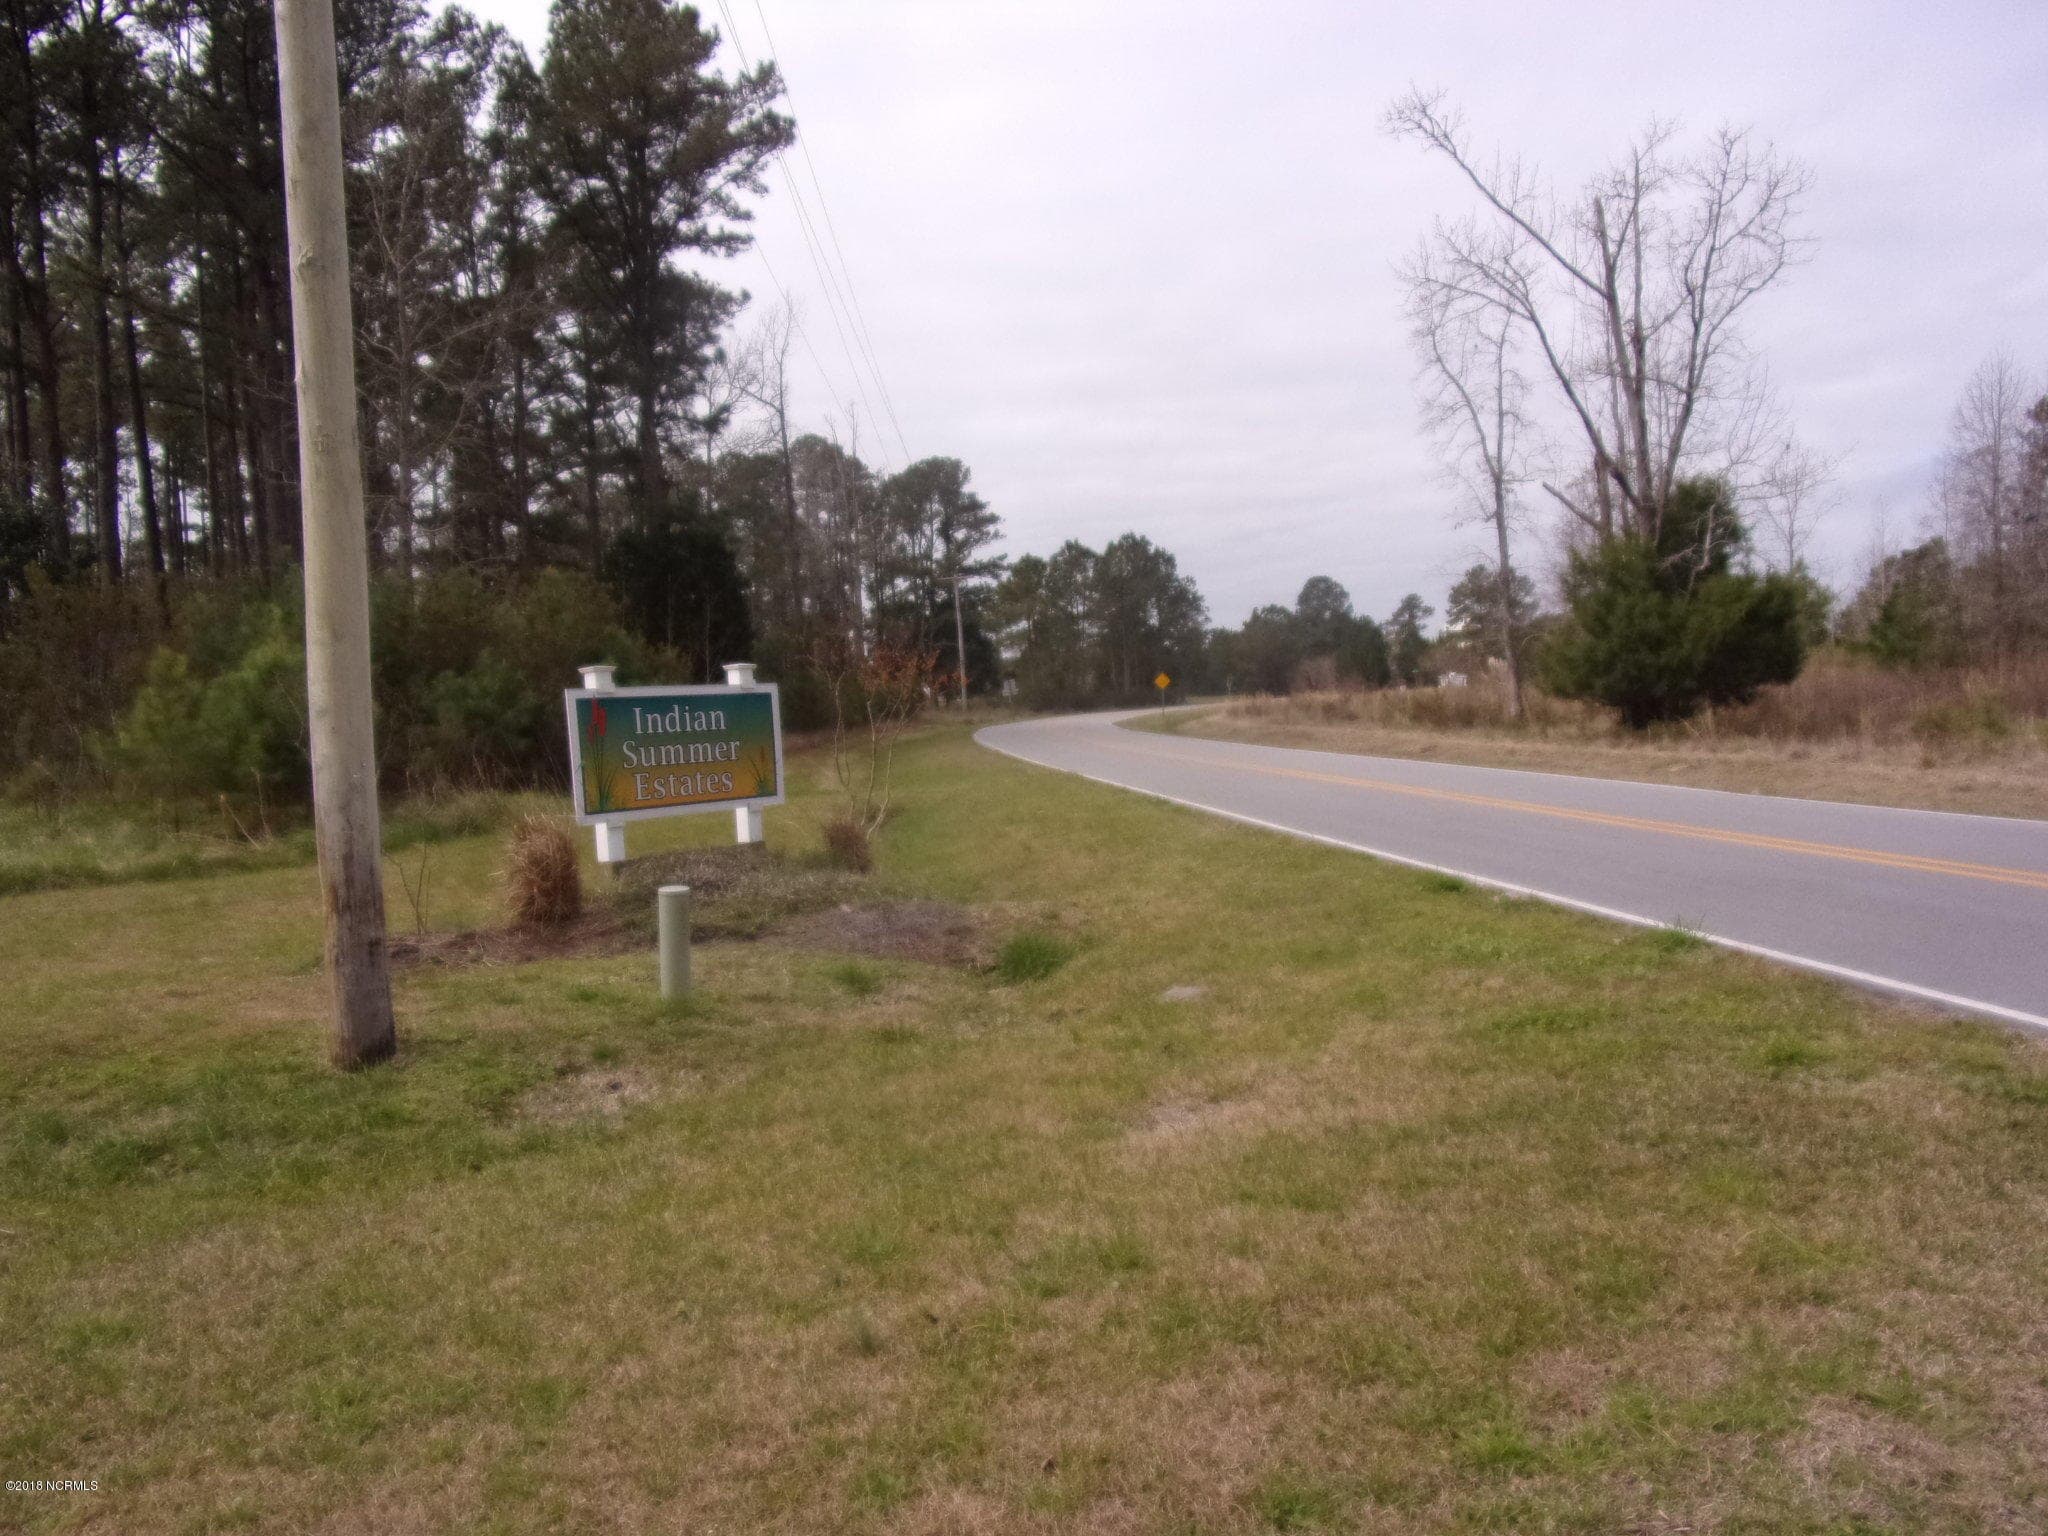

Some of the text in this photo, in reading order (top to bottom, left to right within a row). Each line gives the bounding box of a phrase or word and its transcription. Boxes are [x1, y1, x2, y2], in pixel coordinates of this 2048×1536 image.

[633, 704, 727, 734] Indian
[622, 739, 740, 769] Summer
[634, 771, 734, 801] Estates
